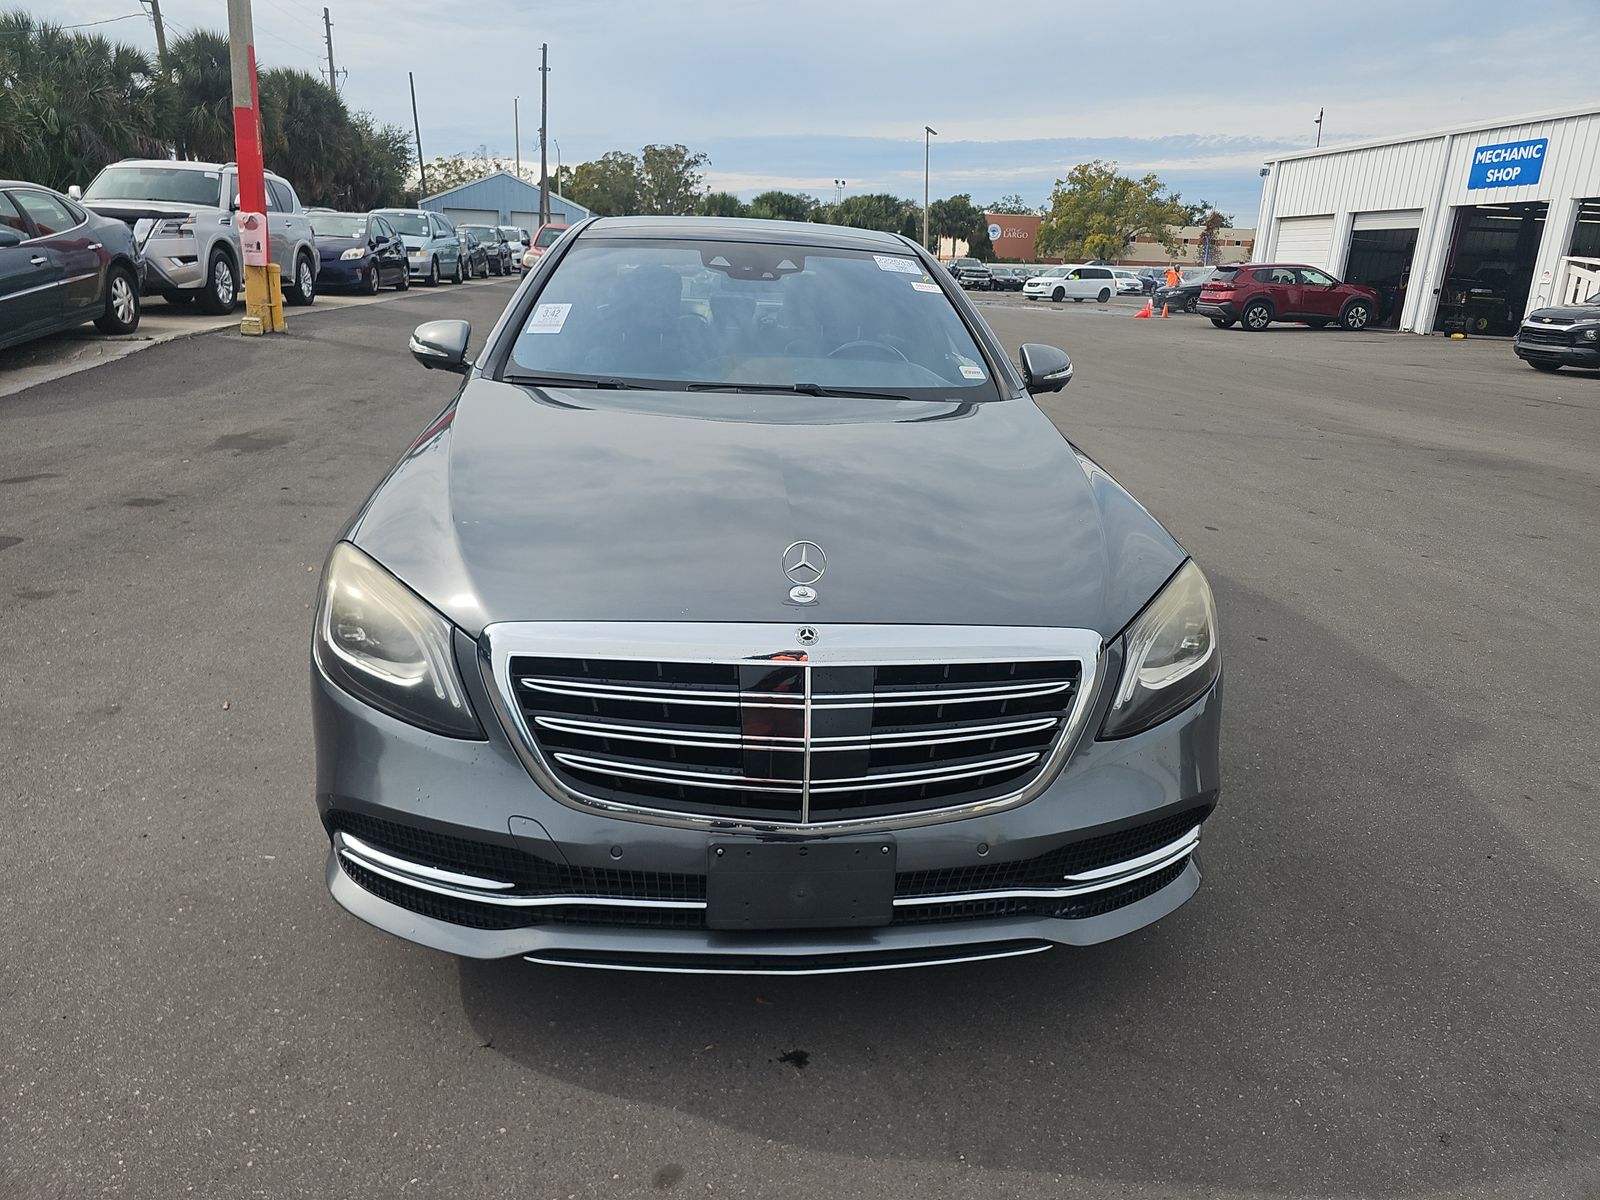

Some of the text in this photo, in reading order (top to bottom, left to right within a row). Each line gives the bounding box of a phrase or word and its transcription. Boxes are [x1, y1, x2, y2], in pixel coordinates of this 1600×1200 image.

[1475, 144, 1543, 164] MECHANIC
[1486, 167, 1521, 182] SHOP
[1003, 230, 1029, 239] LARGO
